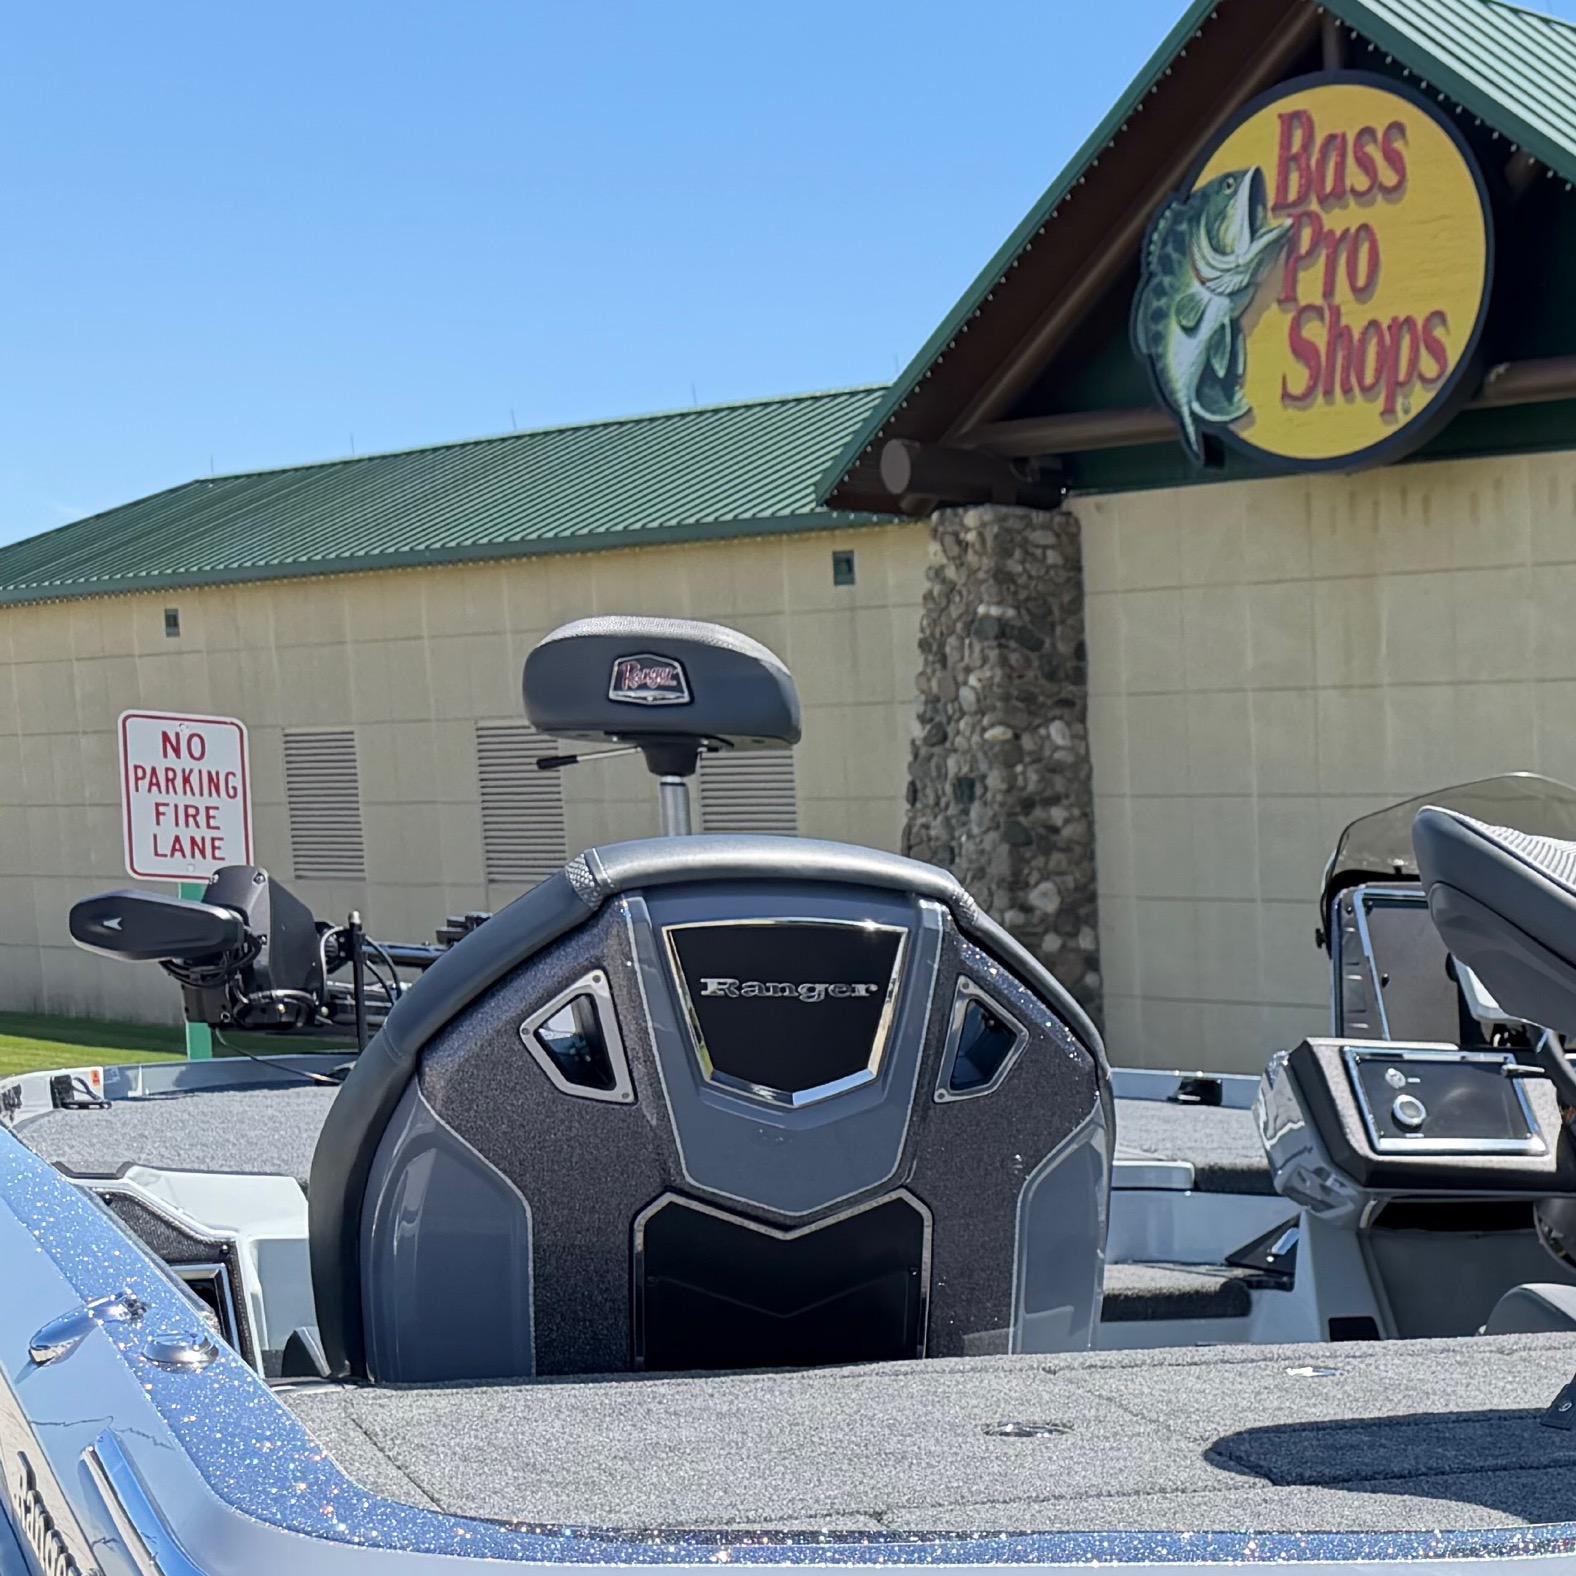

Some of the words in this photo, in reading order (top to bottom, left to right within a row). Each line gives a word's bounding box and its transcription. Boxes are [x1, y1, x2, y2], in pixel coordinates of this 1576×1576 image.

[1271, 109, 1408, 212] Bass
[1277, 209, 1381, 304] Pro
[1281, 303, 1450, 418] Shops
[161, 730, 206, 761] NO
[133, 764, 238, 799] PARKING
[154, 802, 221, 830] FIRE
[153, 833, 226, 861] LANE
[700, 978, 879, 1002] Ranger
